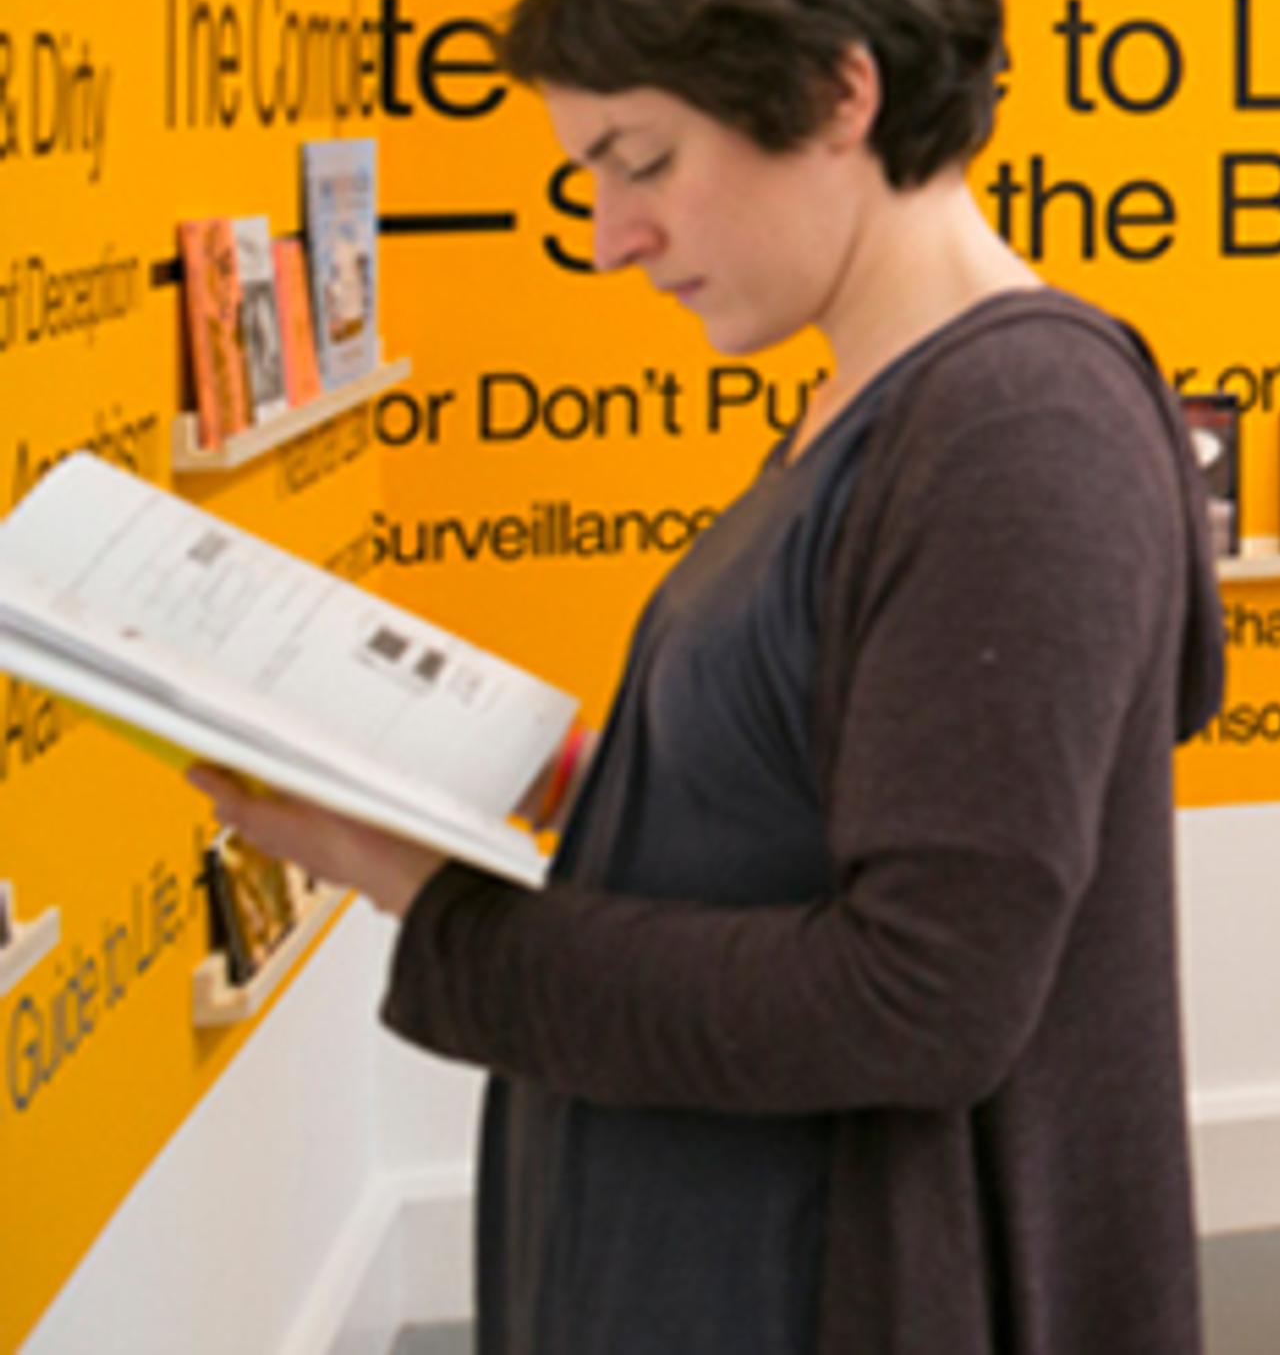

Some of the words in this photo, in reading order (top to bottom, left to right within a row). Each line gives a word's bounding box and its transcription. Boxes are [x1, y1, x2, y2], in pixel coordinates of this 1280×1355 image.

[986, 153, 1180, 265] the
[374, 387, 456, 447] or
[476, 366, 683, 445] Don't
[706, 365, 828, 435] Pu
